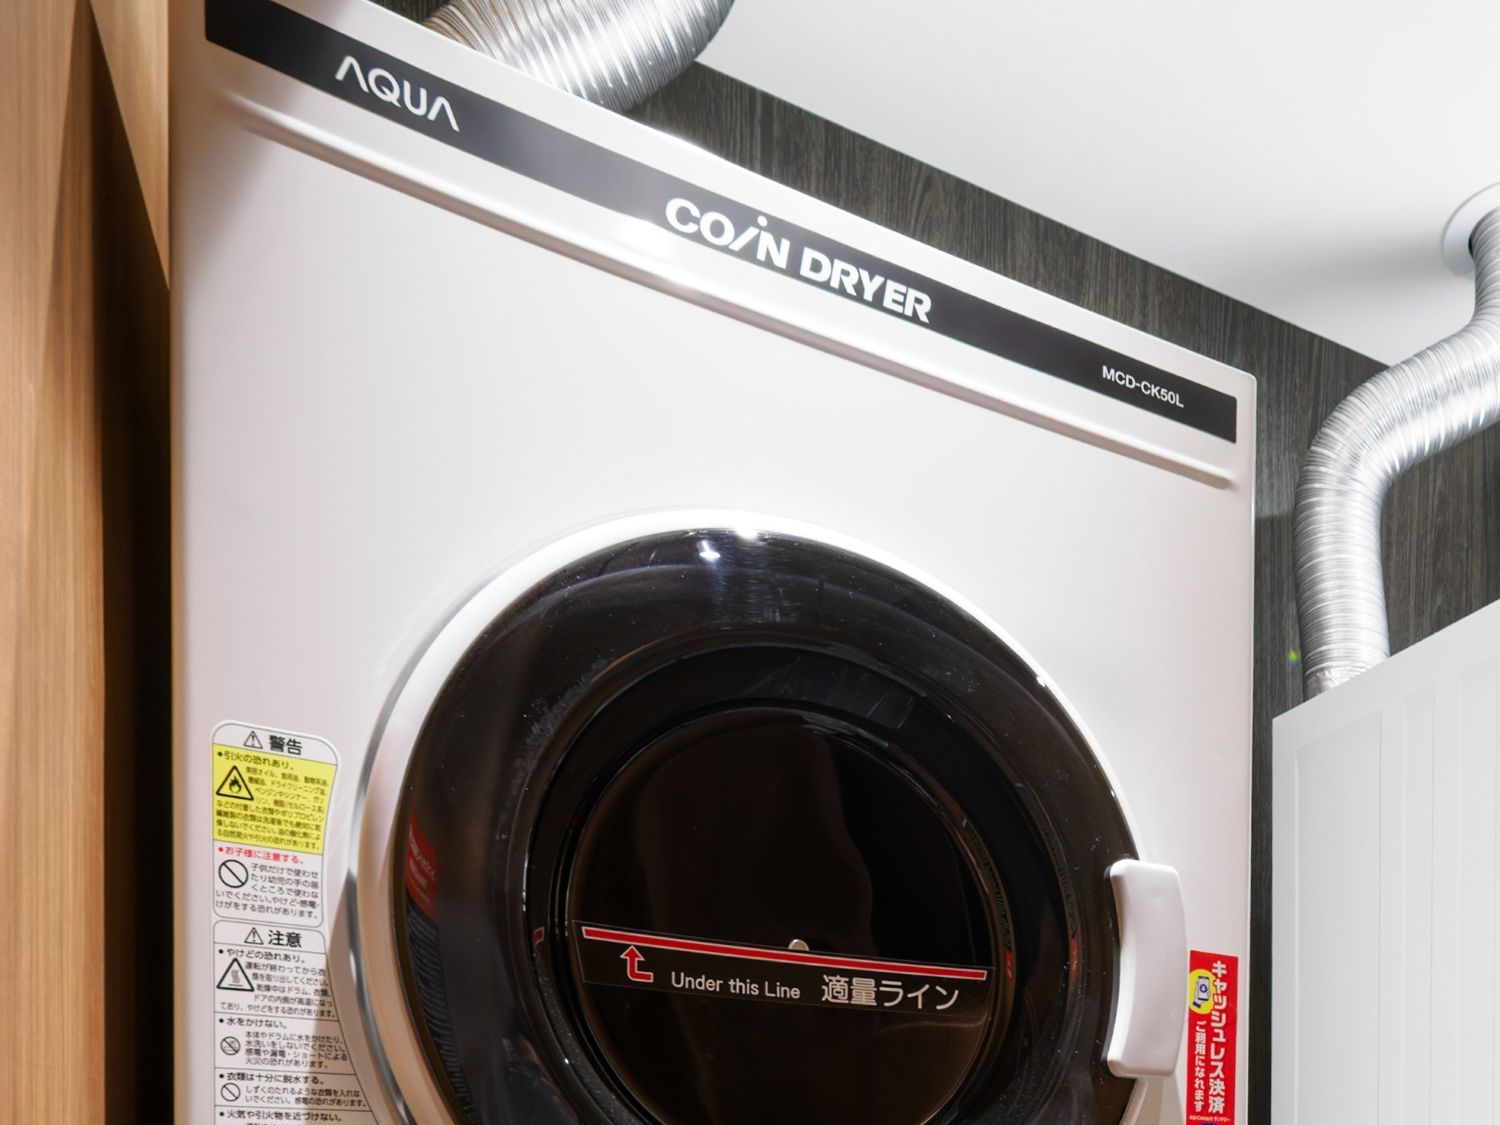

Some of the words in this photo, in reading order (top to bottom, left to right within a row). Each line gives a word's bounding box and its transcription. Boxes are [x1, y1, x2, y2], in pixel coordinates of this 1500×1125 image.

[334, 55, 460, 132] AQUA
[665, 197, 791, 270] COIN
[798, 252, 932, 325] DRYER
[1101, 364, 1185, 409] MCD-CK50L
[269, 735, 302, 755] 警告
[268, 929, 302, 948] 注意
[227, 949, 305, 964] やけどの恐れあり。
[671, 971, 722, 993] Under
[728, 977, 759, 996] this
[765, 981, 800, 999] Line
[822, 975, 959, 1010] 適量ライン
[227, 1016, 287, 1029] 水をかけない。
[1208, 960, 1228, 1114] キャッシュレス決済
[227, 1072, 325, 1085] 衣類は十分に脱水する。
[227, 1110, 343, 1122] 火気や引火物を近づけない。
